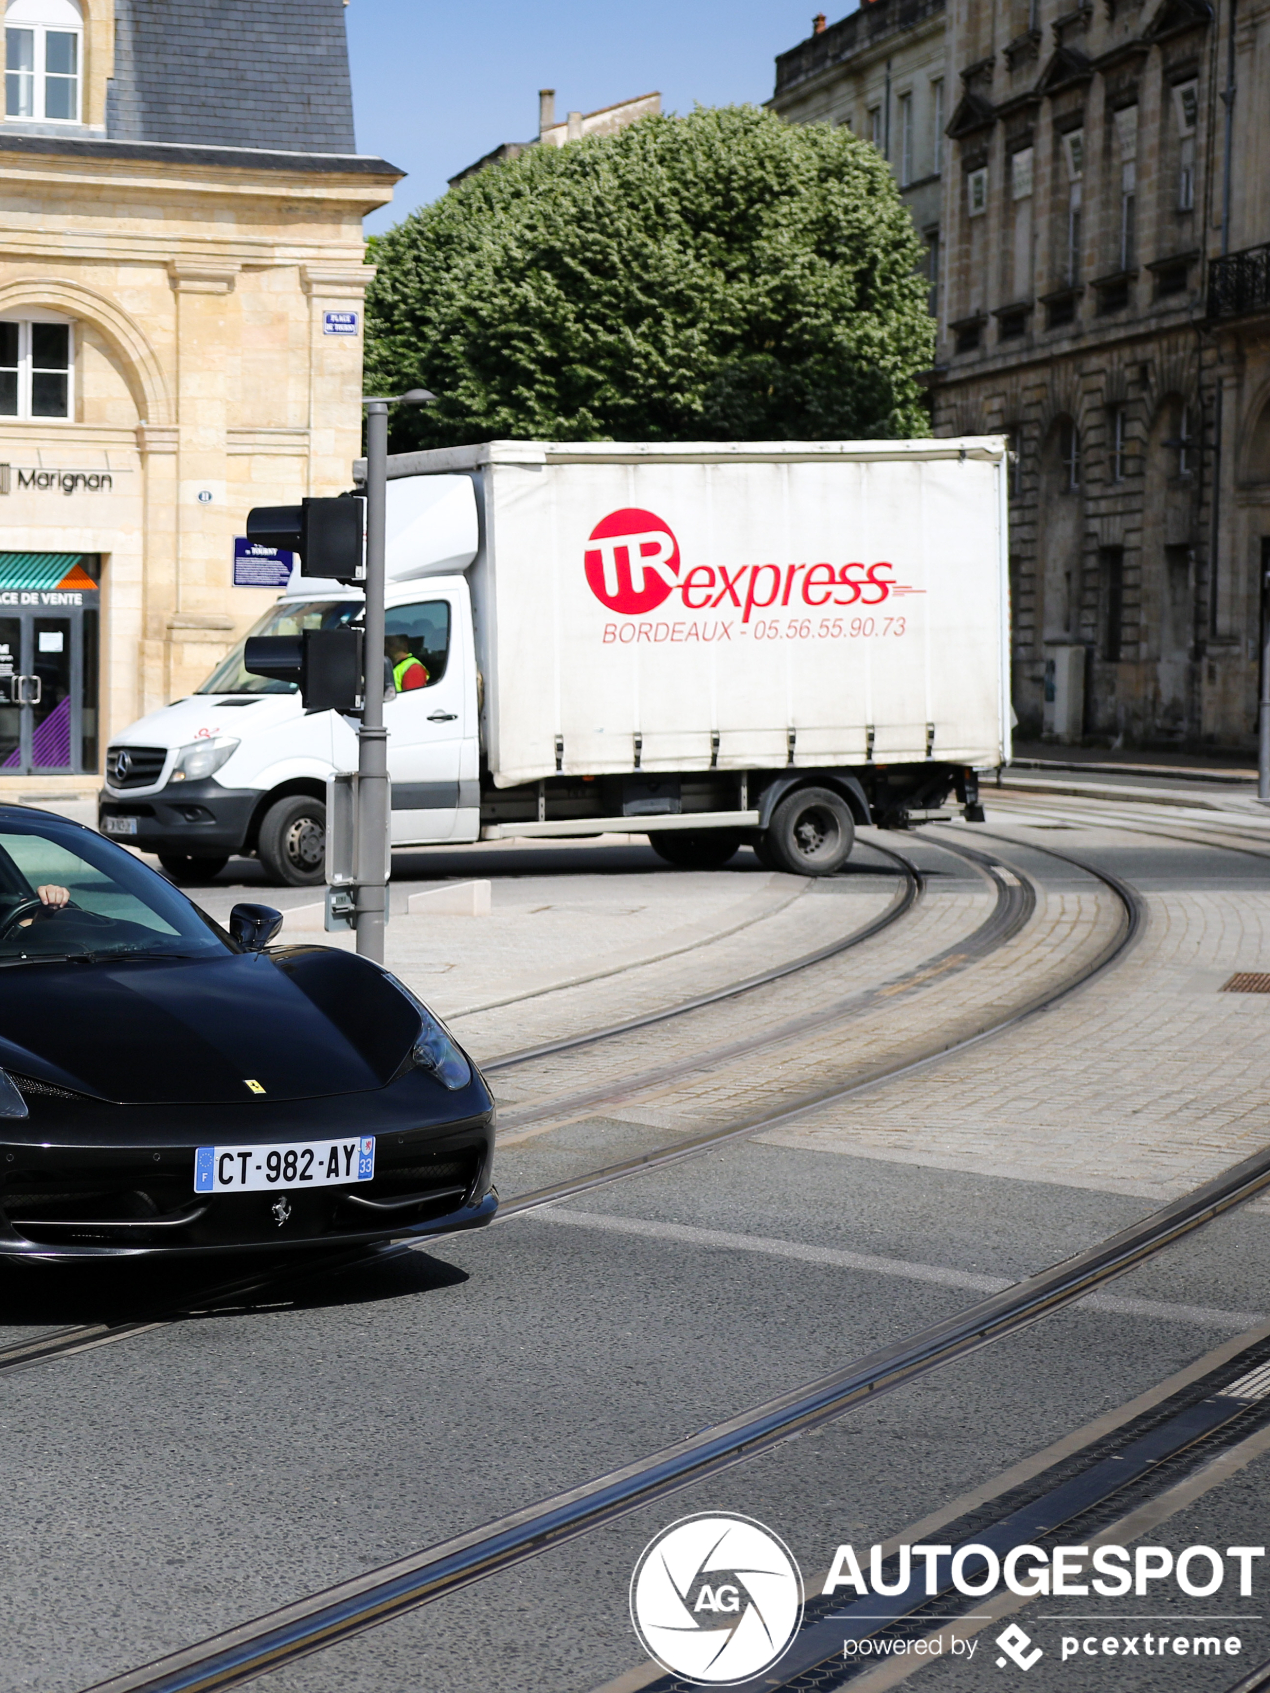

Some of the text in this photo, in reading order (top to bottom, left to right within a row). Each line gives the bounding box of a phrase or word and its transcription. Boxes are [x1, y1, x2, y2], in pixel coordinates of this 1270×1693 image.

[18, 469, 113, 496] Marignan
[584, 530, 896, 623] TR express
[21, 592, 40, 605] DE
[41, 592, 82, 606] VENTE
[602, 620, 734, 643] BORDEAUX
[753, 616, 906, 640] 05.56.55.90.73
[202, 1172, 208, 1182] F
[218, 1144, 356, 1185] CT-982-AY
[359, 1158, 372, 1174] 33
